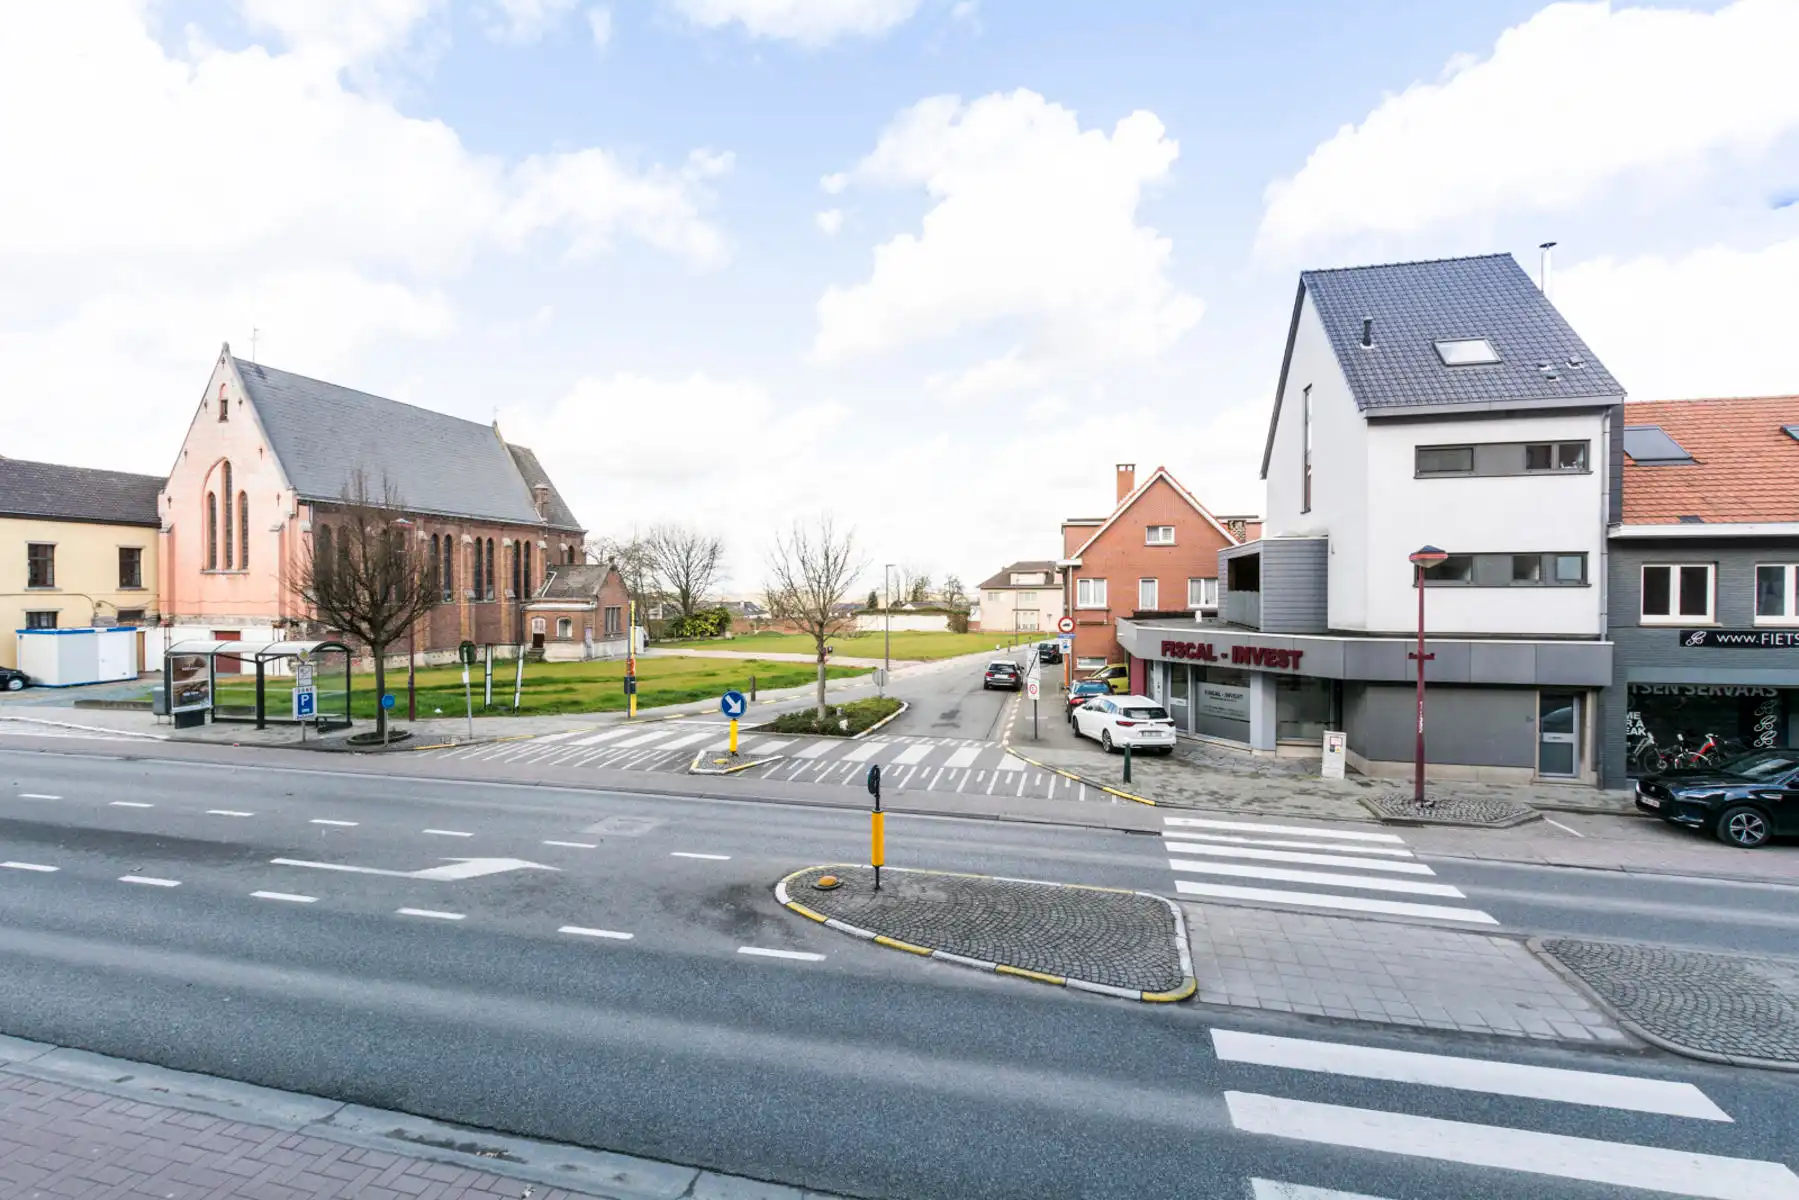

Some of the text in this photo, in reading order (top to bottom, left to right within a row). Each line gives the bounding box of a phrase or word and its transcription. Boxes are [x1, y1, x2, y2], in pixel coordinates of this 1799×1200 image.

[1161, 640, 1218, 662] FISCAL
[1231, 645, 1303, 670] INVEST
[301, 695, 309, 706] P
